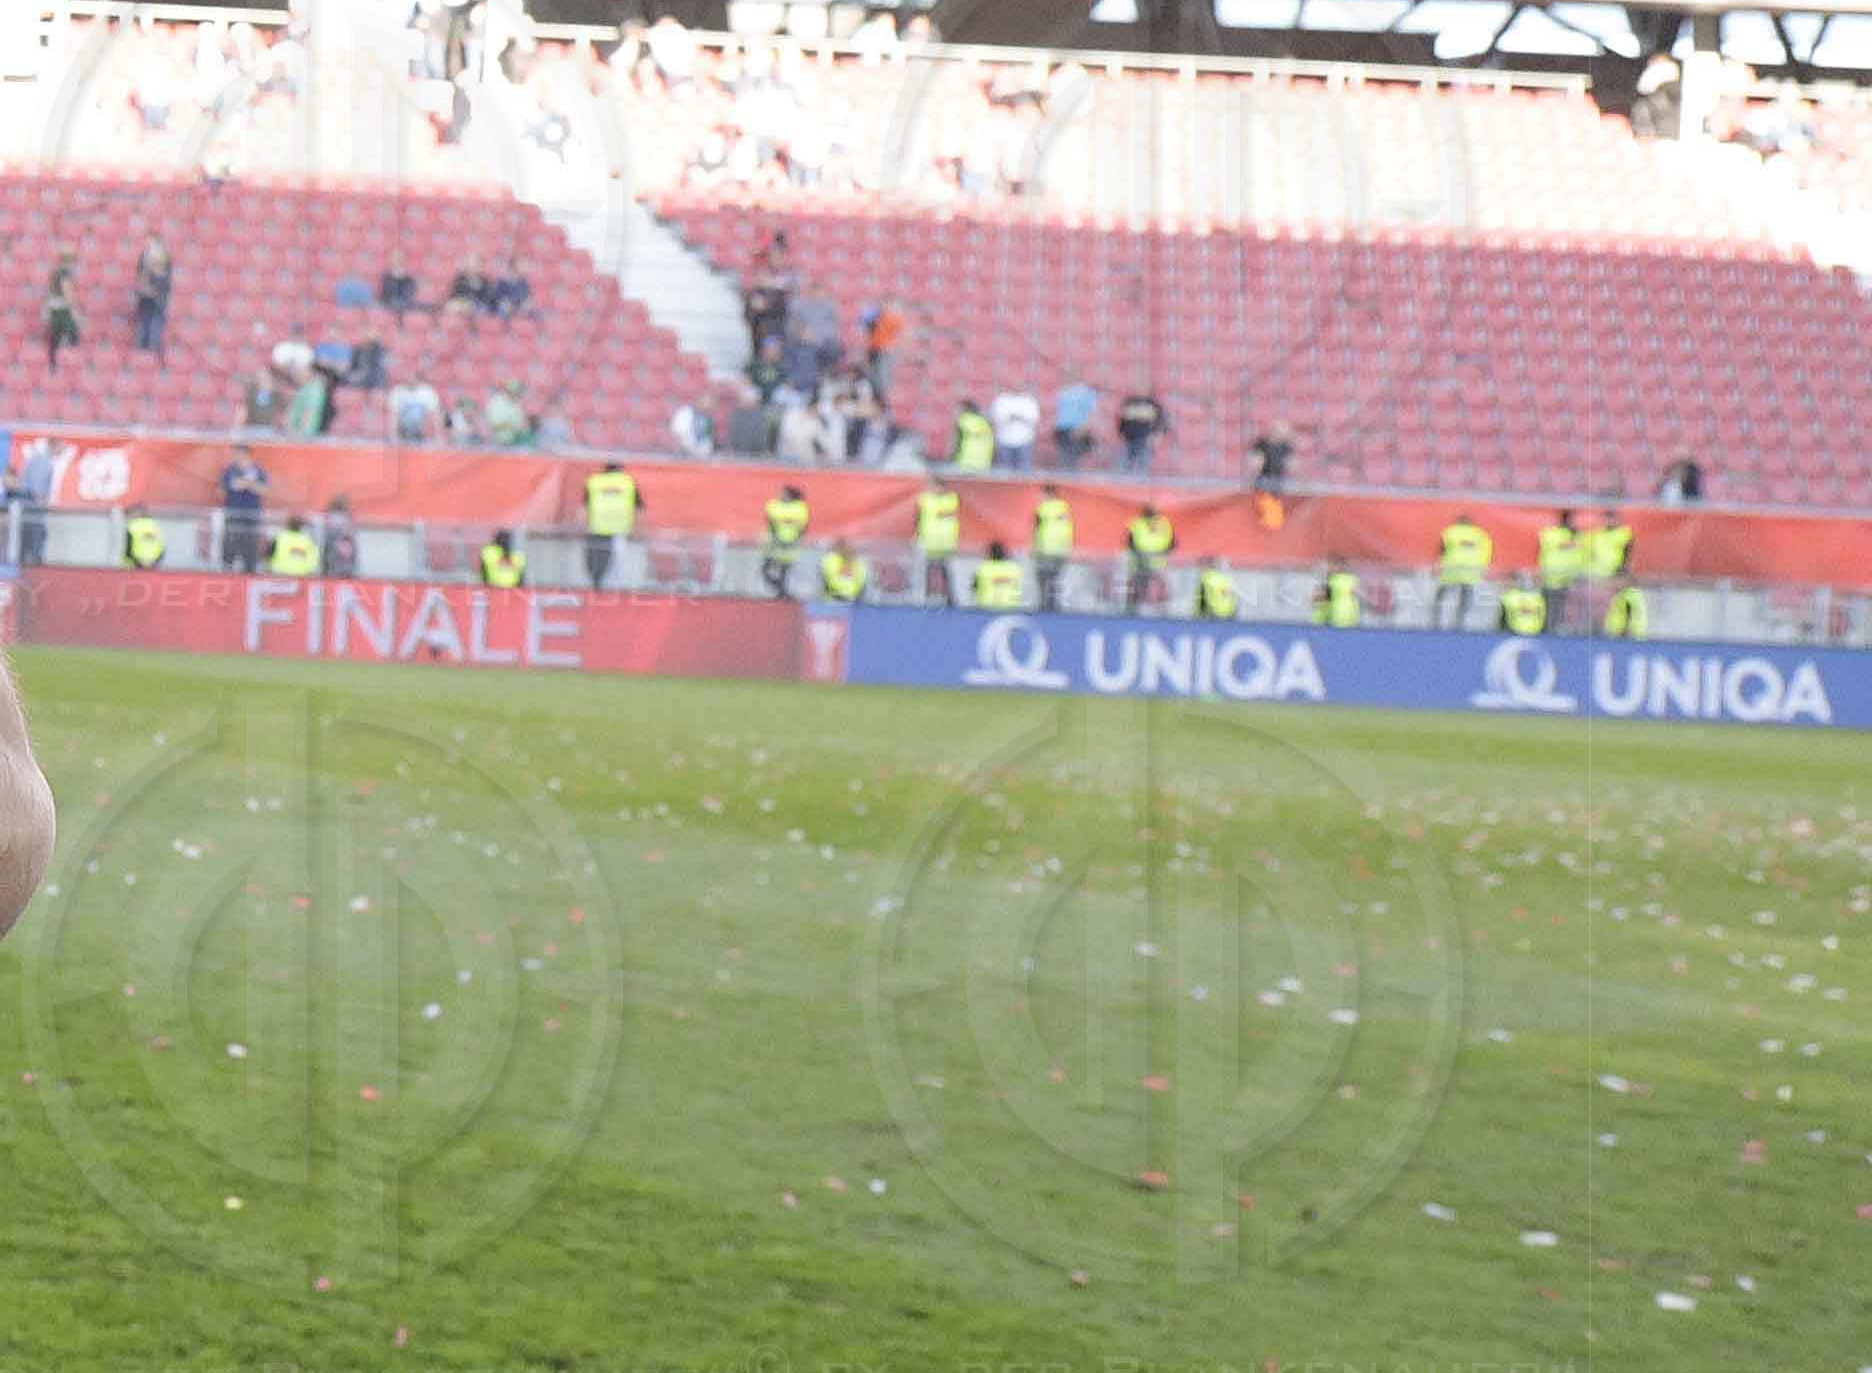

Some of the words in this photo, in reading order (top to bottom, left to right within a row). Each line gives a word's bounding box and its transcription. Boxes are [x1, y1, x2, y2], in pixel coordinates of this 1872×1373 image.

[242, 578, 585, 669] FINALE
[1083, 630, 1326, 701] UNIQA
[1590, 654, 1833, 725] UNIQA
